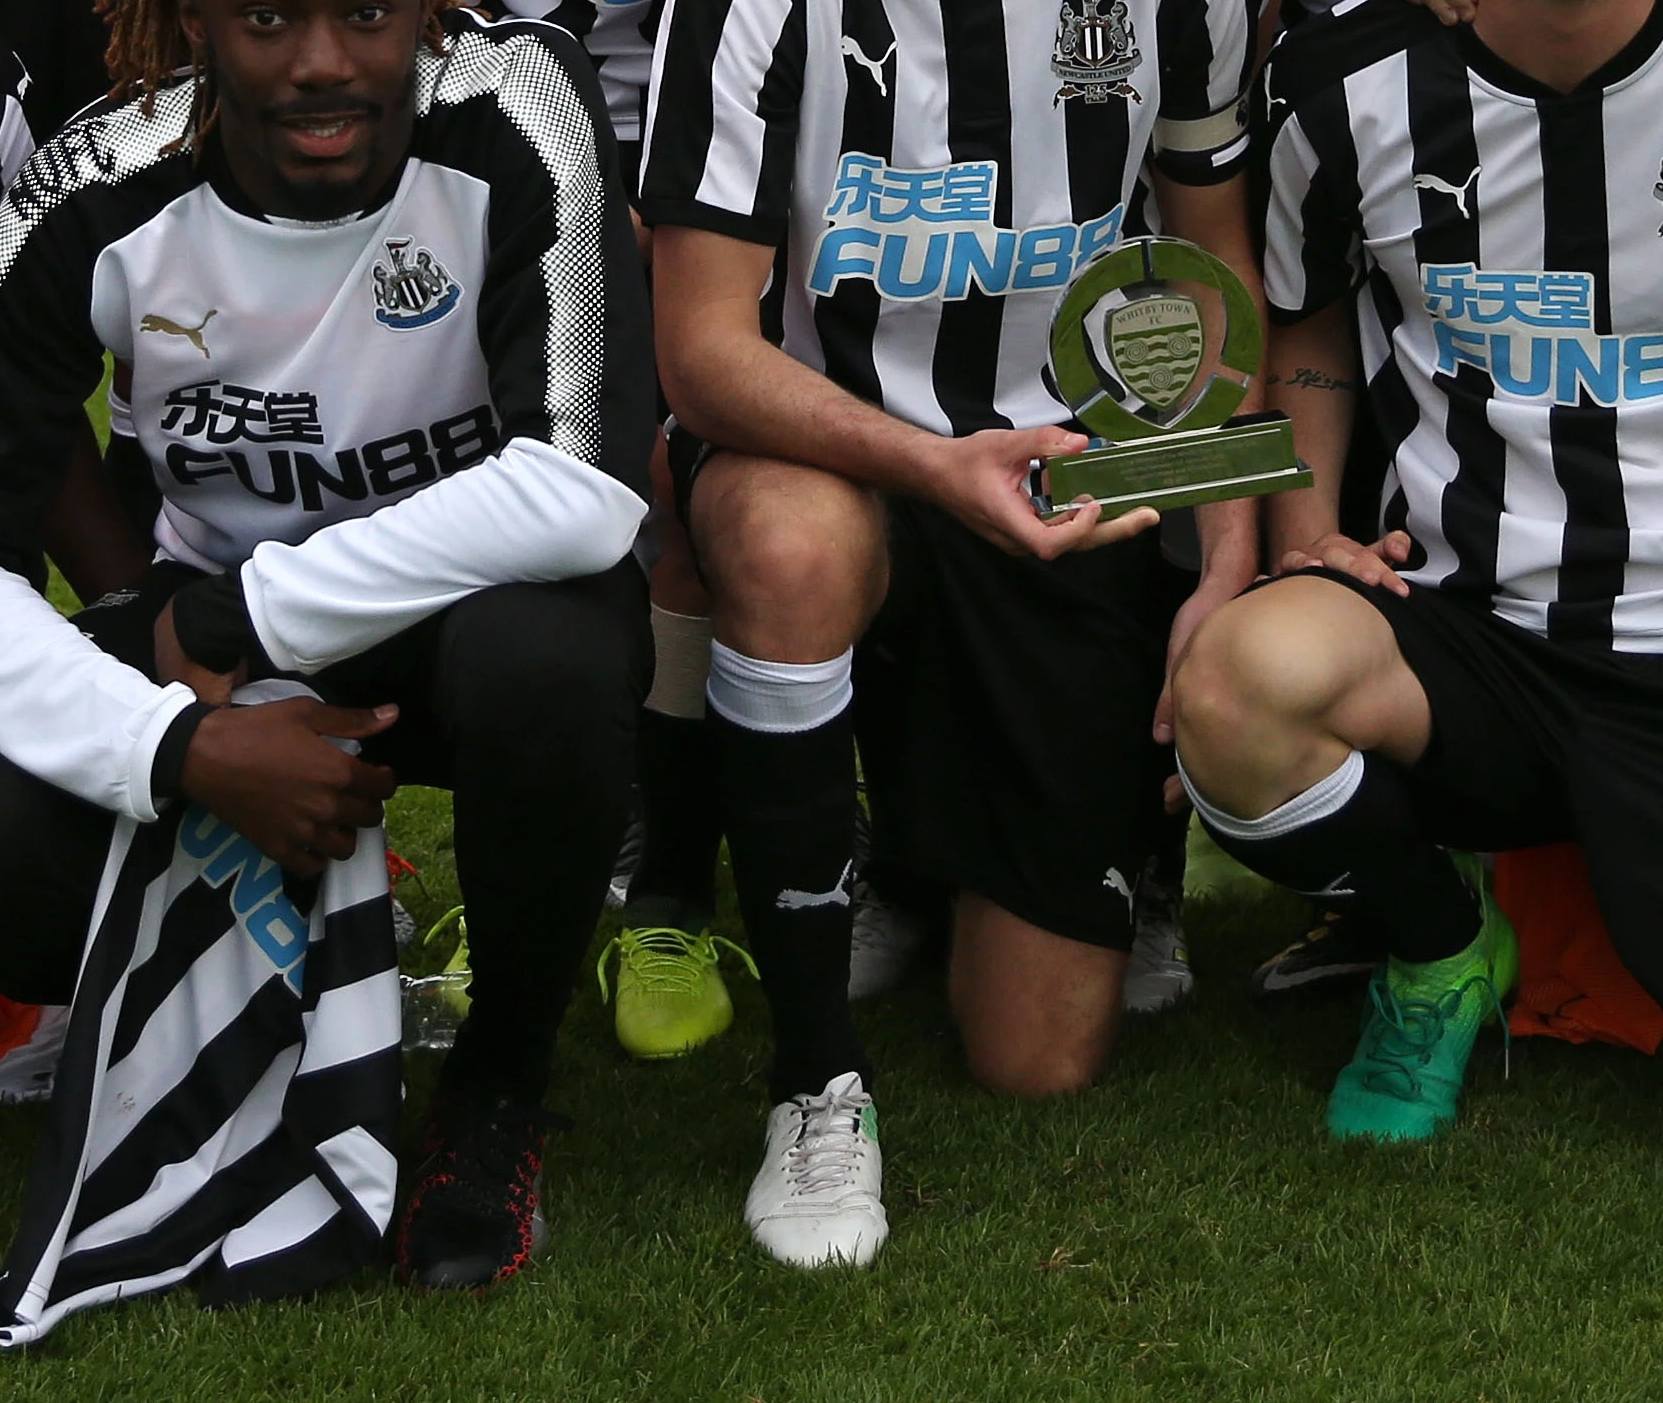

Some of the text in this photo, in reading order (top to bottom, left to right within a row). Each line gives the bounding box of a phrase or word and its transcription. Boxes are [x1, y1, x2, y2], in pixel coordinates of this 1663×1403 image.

[1059, 65, 1131, 79] NEWCASTLE UNITED
[1085, 85, 1106, 96] 125
[827, 155, 993, 223] 乐天堂
[1116, 302, 1192, 324] WHITBY TOWN
[1425, 267, 1590, 328] 乐天堂
[1150, 315, 1163, 325] FC
[161, 379, 324, 445] 乐天堂
[165, 404, 500, 512] FUN88
